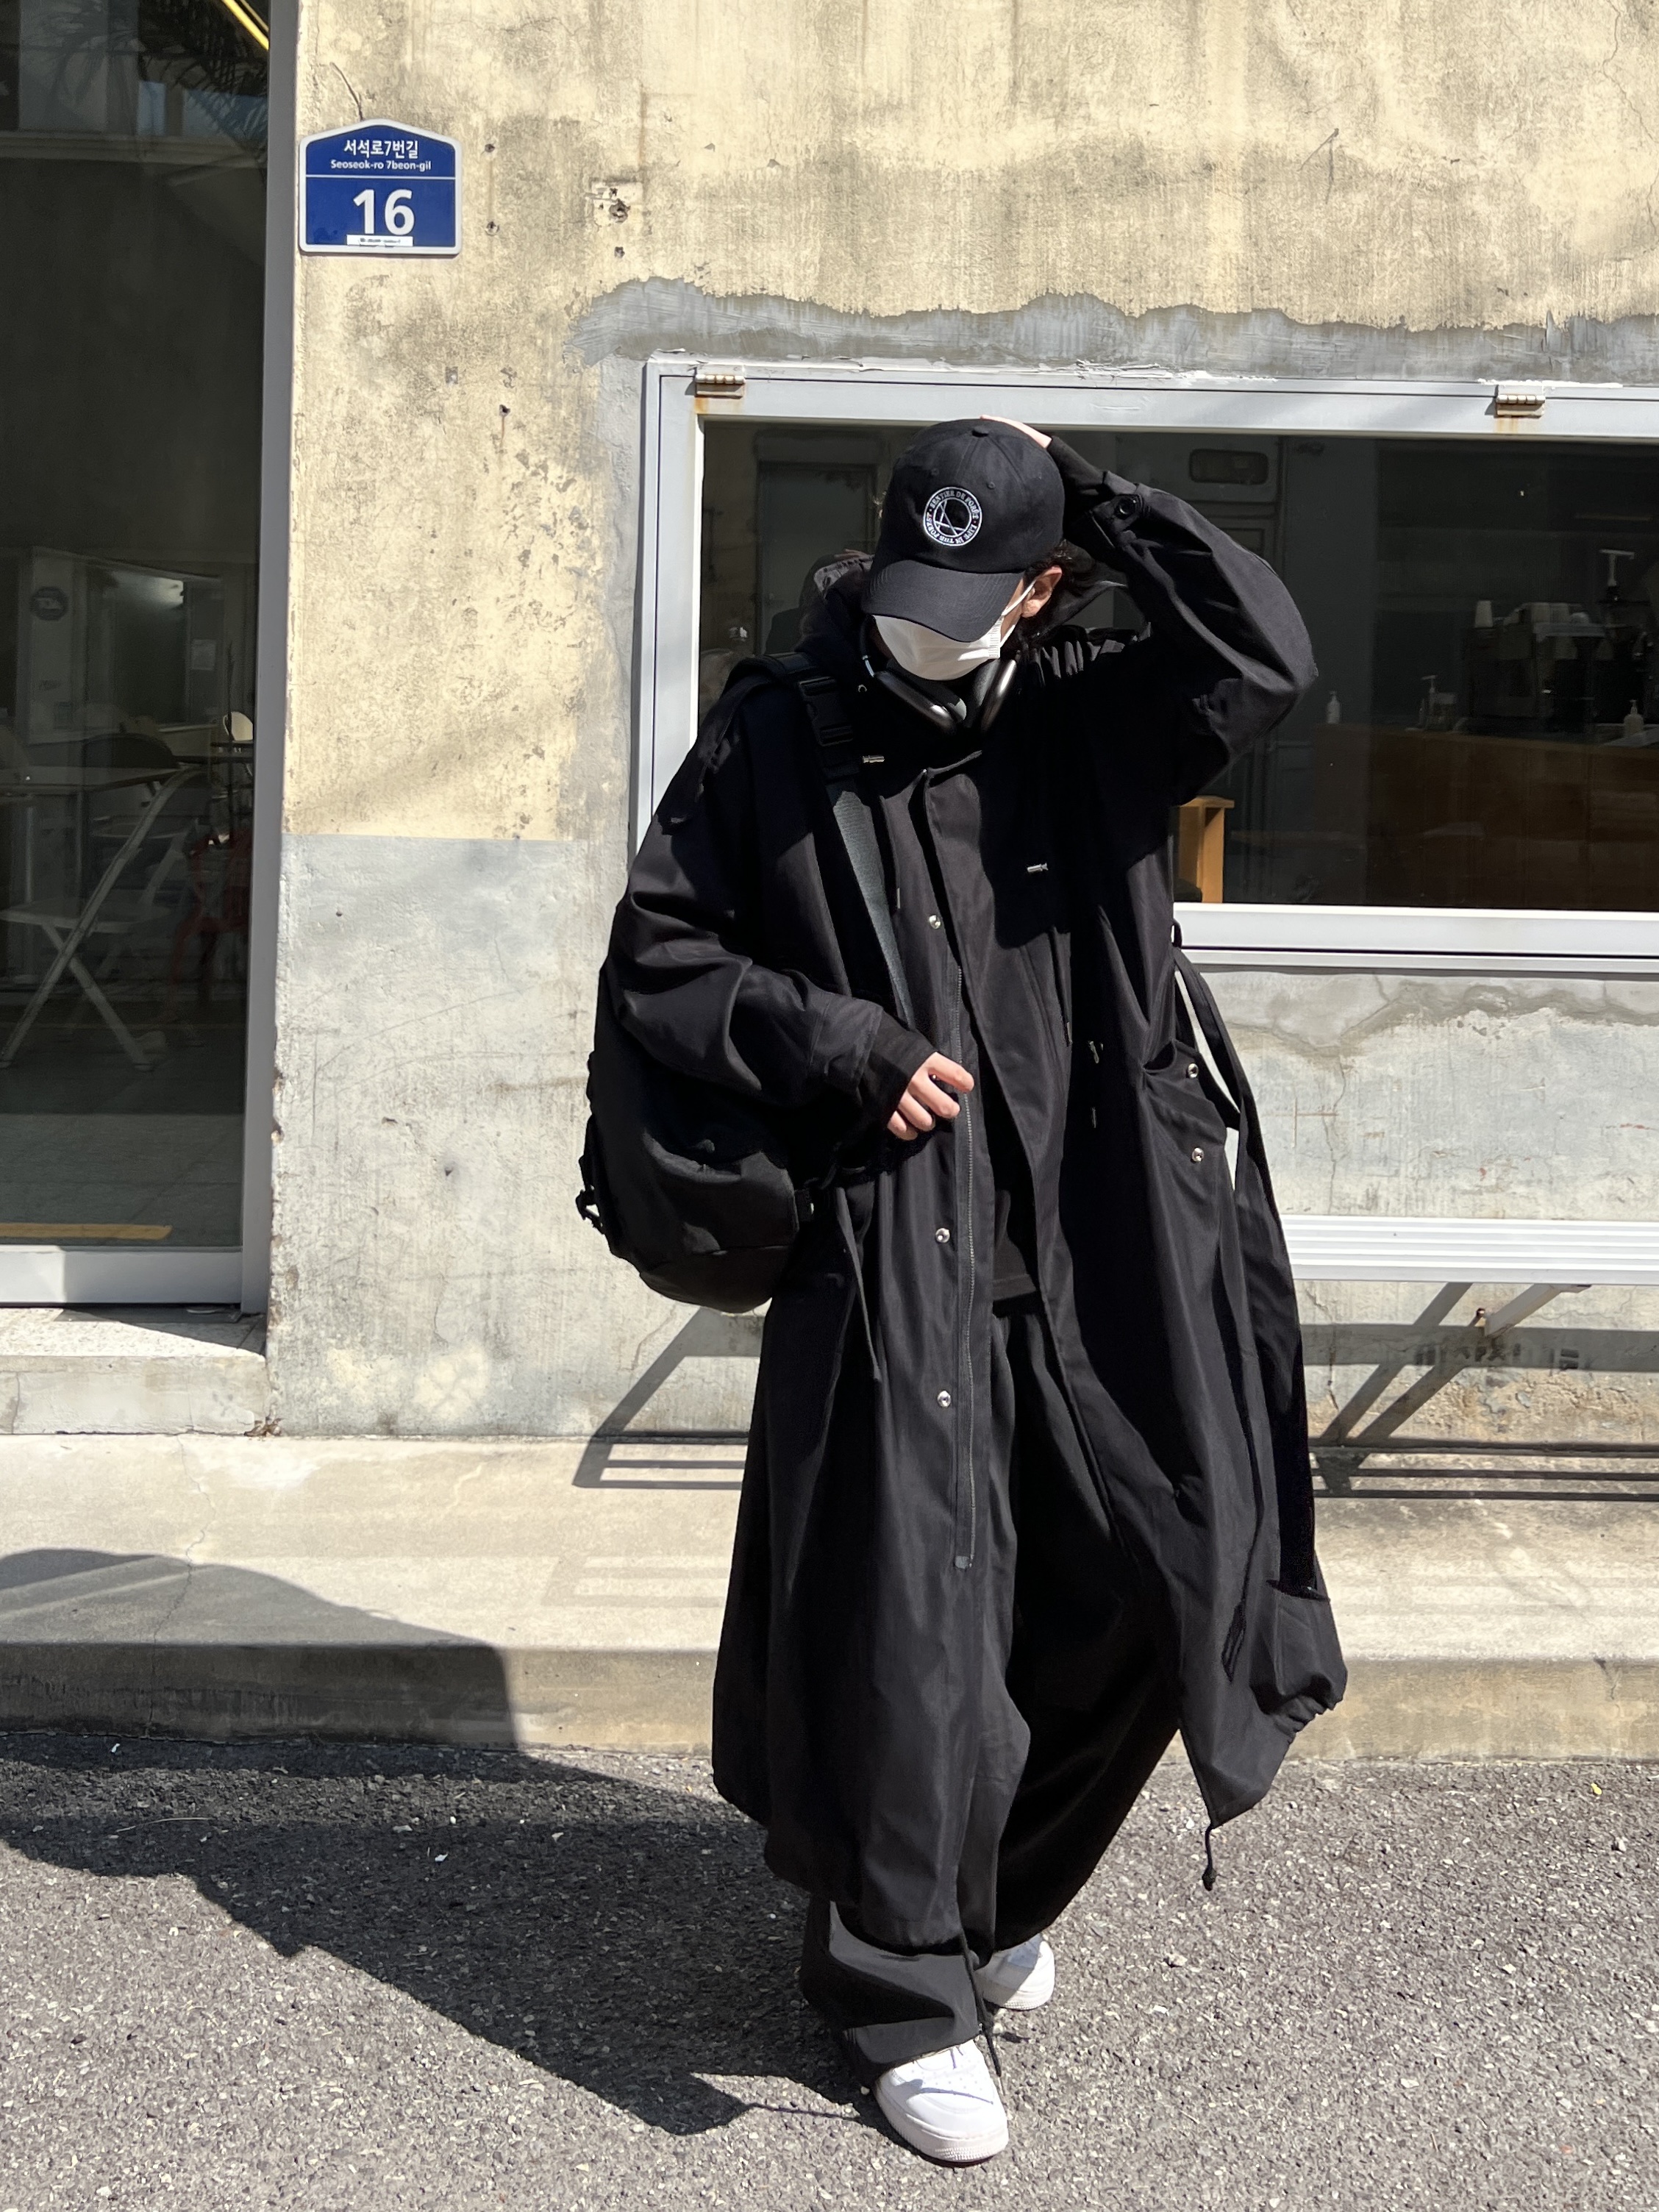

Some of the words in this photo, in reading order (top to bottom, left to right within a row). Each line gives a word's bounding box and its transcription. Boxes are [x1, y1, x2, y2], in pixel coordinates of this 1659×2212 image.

[344, 140, 418, 159] 서석로7번길
[331, 160, 384, 170] Seoseok-ro
[386, 160, 432, 172] 7beon-gil
[353, 189, 415, 235] 16
[956, 491, 966, 499] DE
[927, 512, 939, 538] FOREST
[963, 524, 977, 539] LIFE
[939, 535, 955, 543] THE
